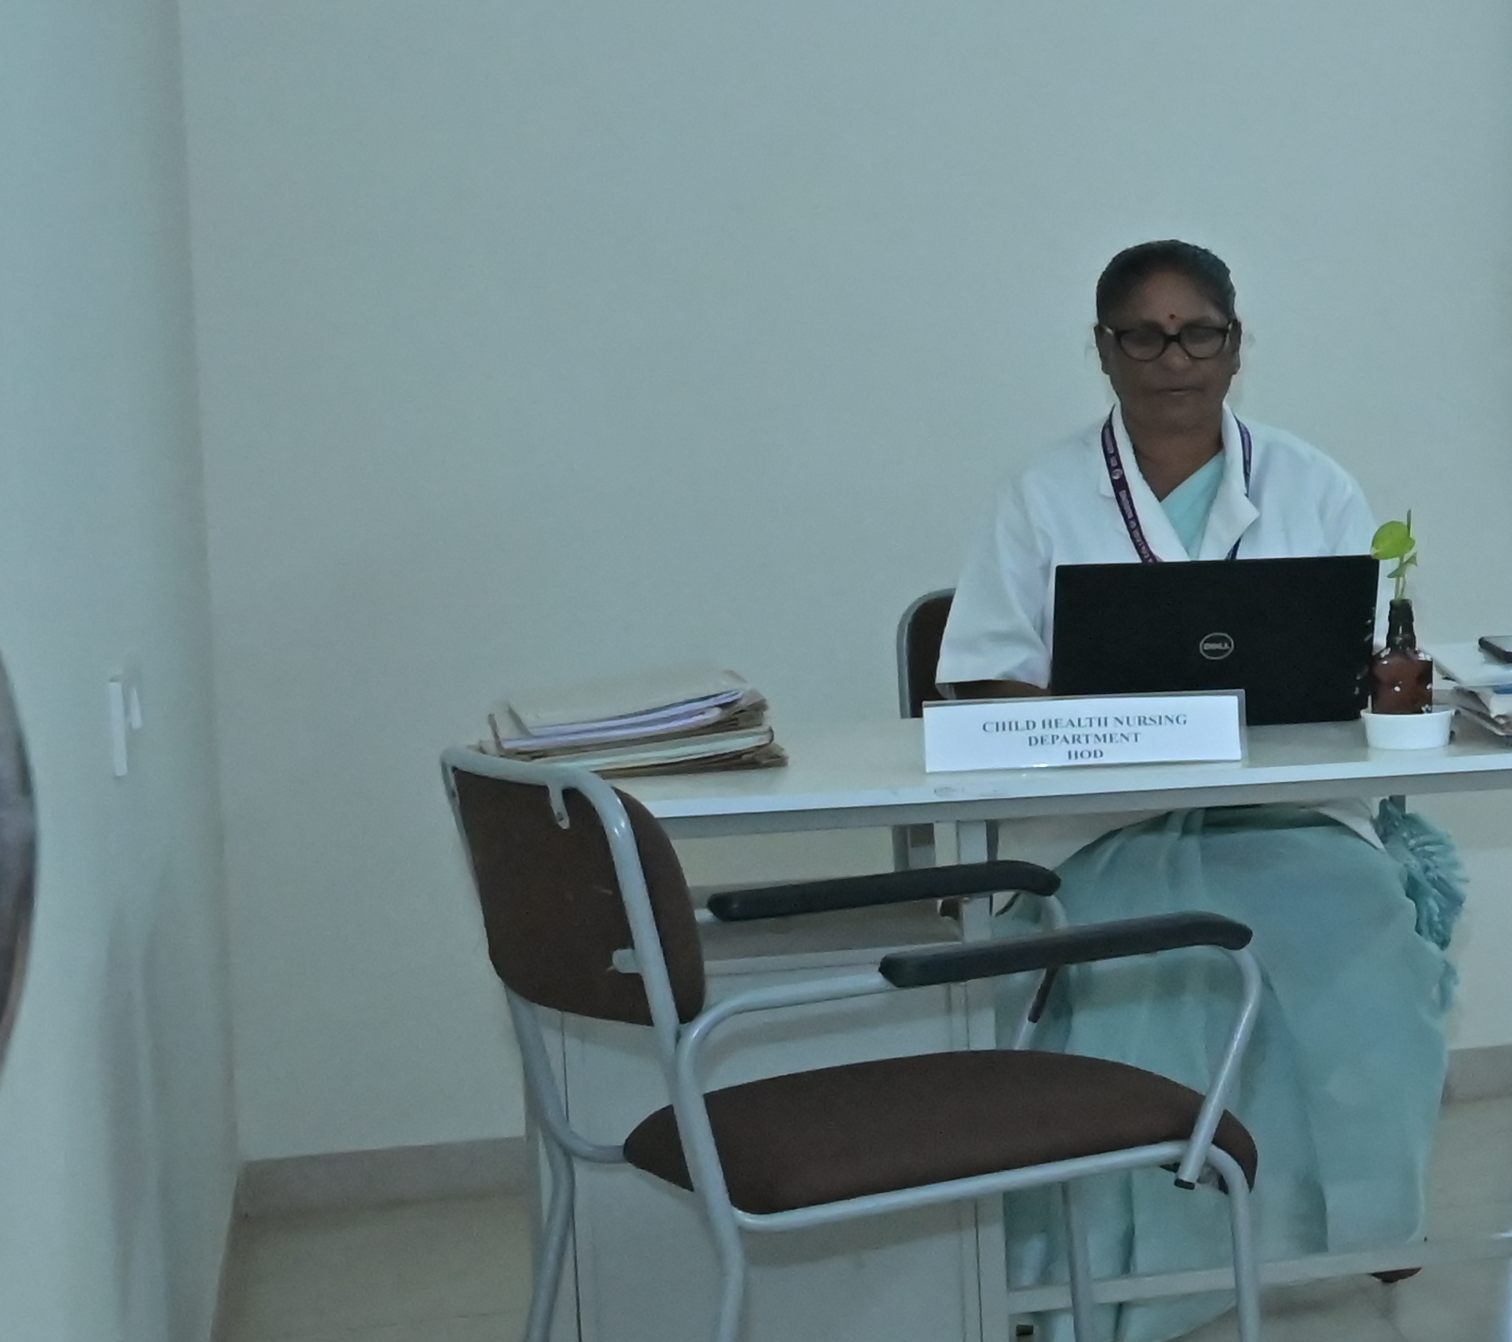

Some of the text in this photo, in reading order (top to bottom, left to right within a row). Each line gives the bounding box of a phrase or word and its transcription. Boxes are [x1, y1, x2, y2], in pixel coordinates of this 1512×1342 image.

[982, 713, 1188, 733] CHILD HEALTH NURSING
[1027, 732, 1142, 747] DEPARTMENT
[1067, 749, 1105, 761] HOD
